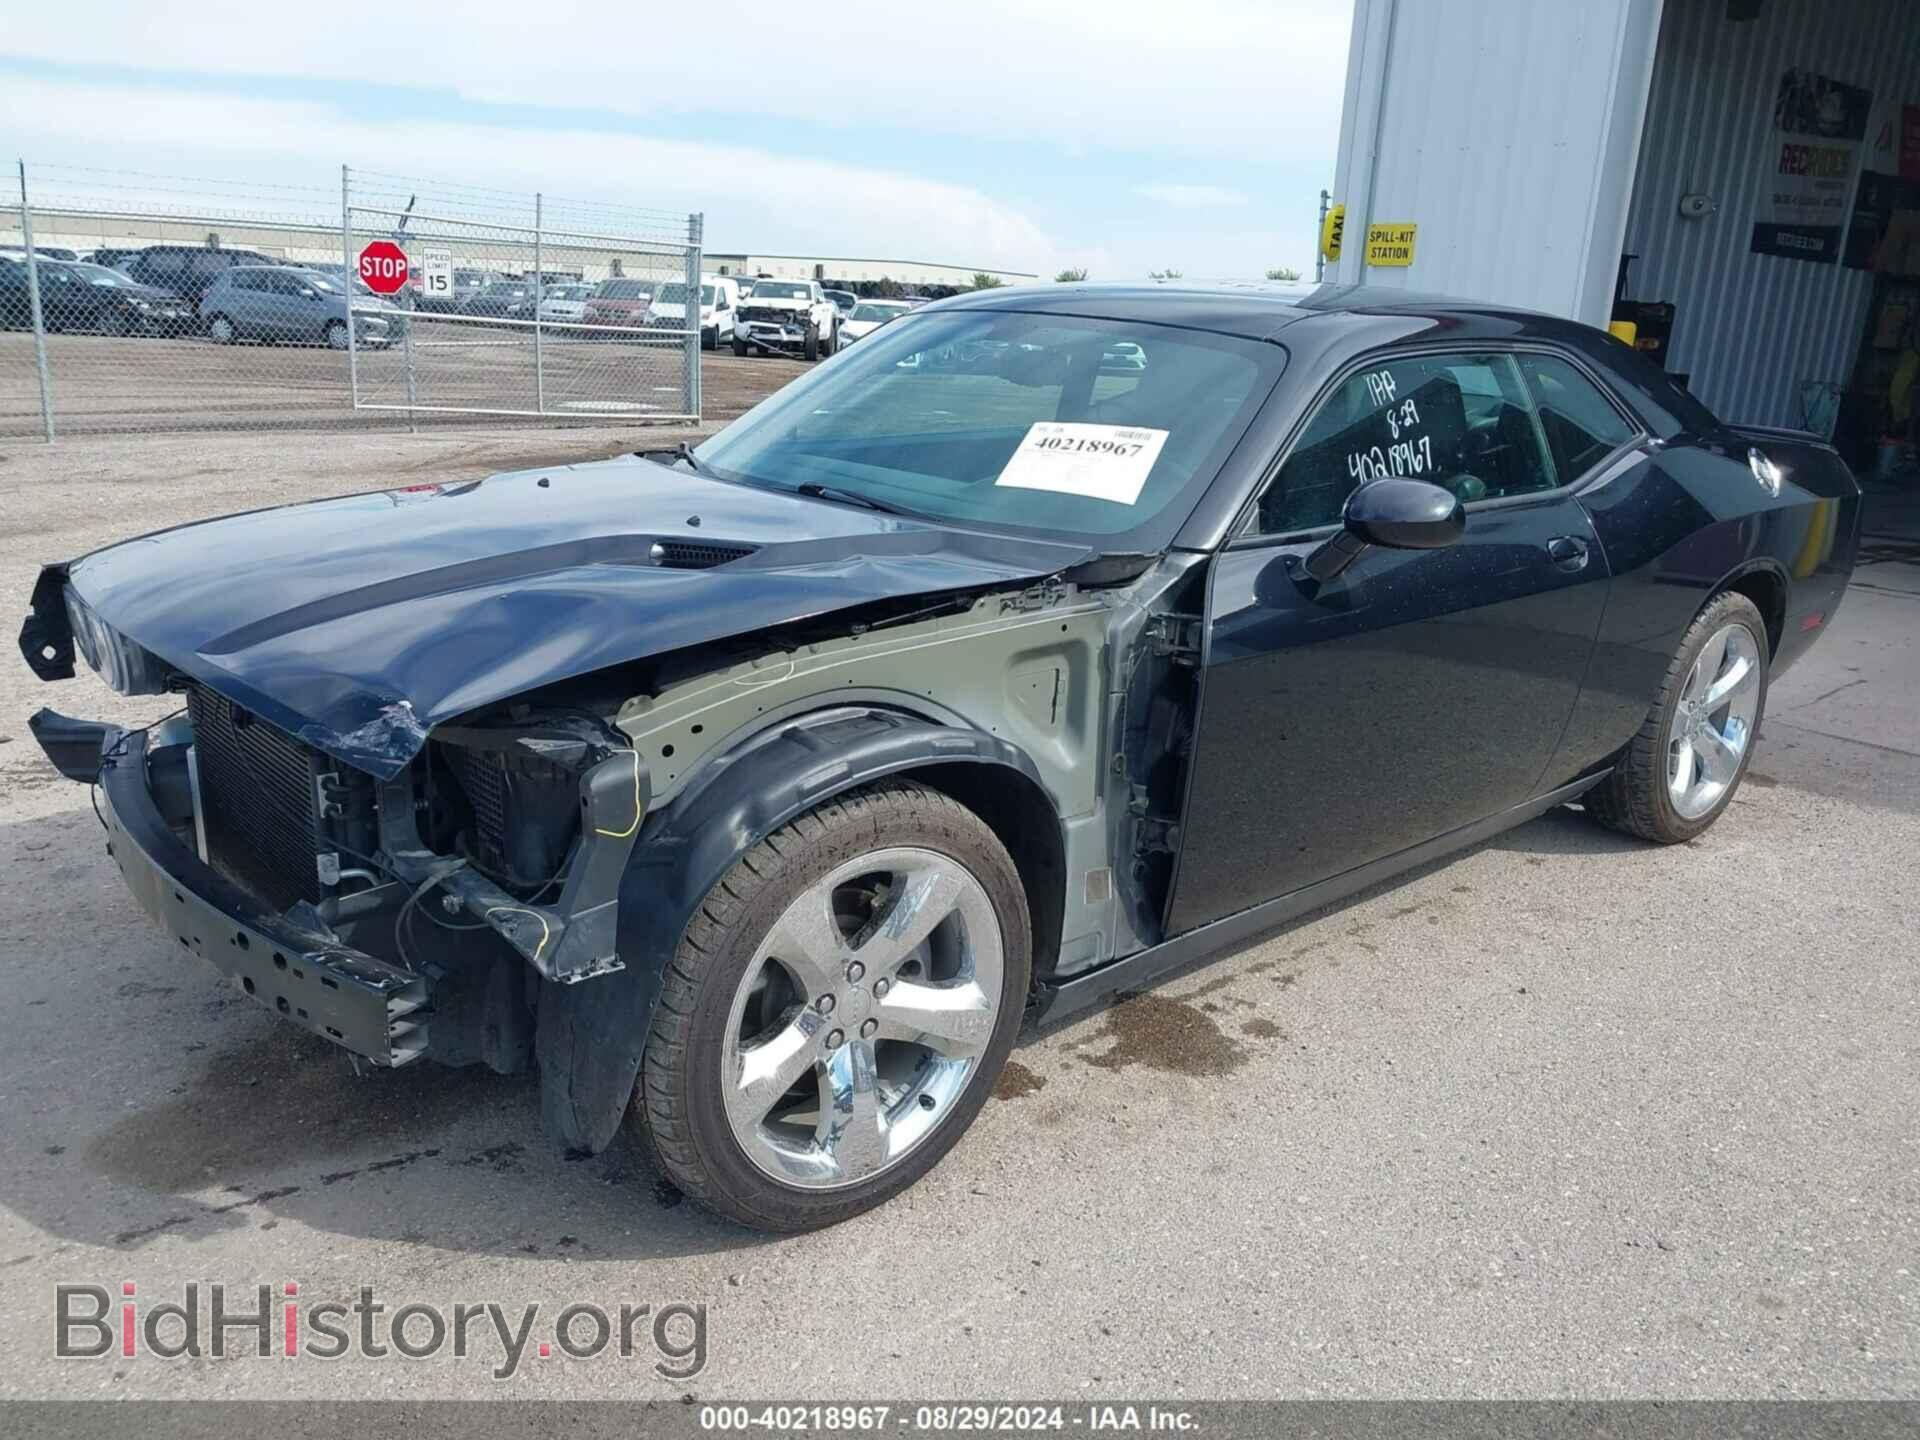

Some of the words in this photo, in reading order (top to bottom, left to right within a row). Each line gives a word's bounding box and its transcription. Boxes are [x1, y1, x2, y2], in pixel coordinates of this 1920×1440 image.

[1329, 215, 1345, 249] TAXI
[1369, 231, 1415, 243] SPILL-KIT
[425, 253, 450, 261] SPEED
[1371, 247, 1409, 259] STATION
[362, 256, 406, 278] STOP
[429, 275, 448, 291] 15
[1034, 437, 1144, 457] 40218967
[1348, 435, 1432, 485] 40218967
